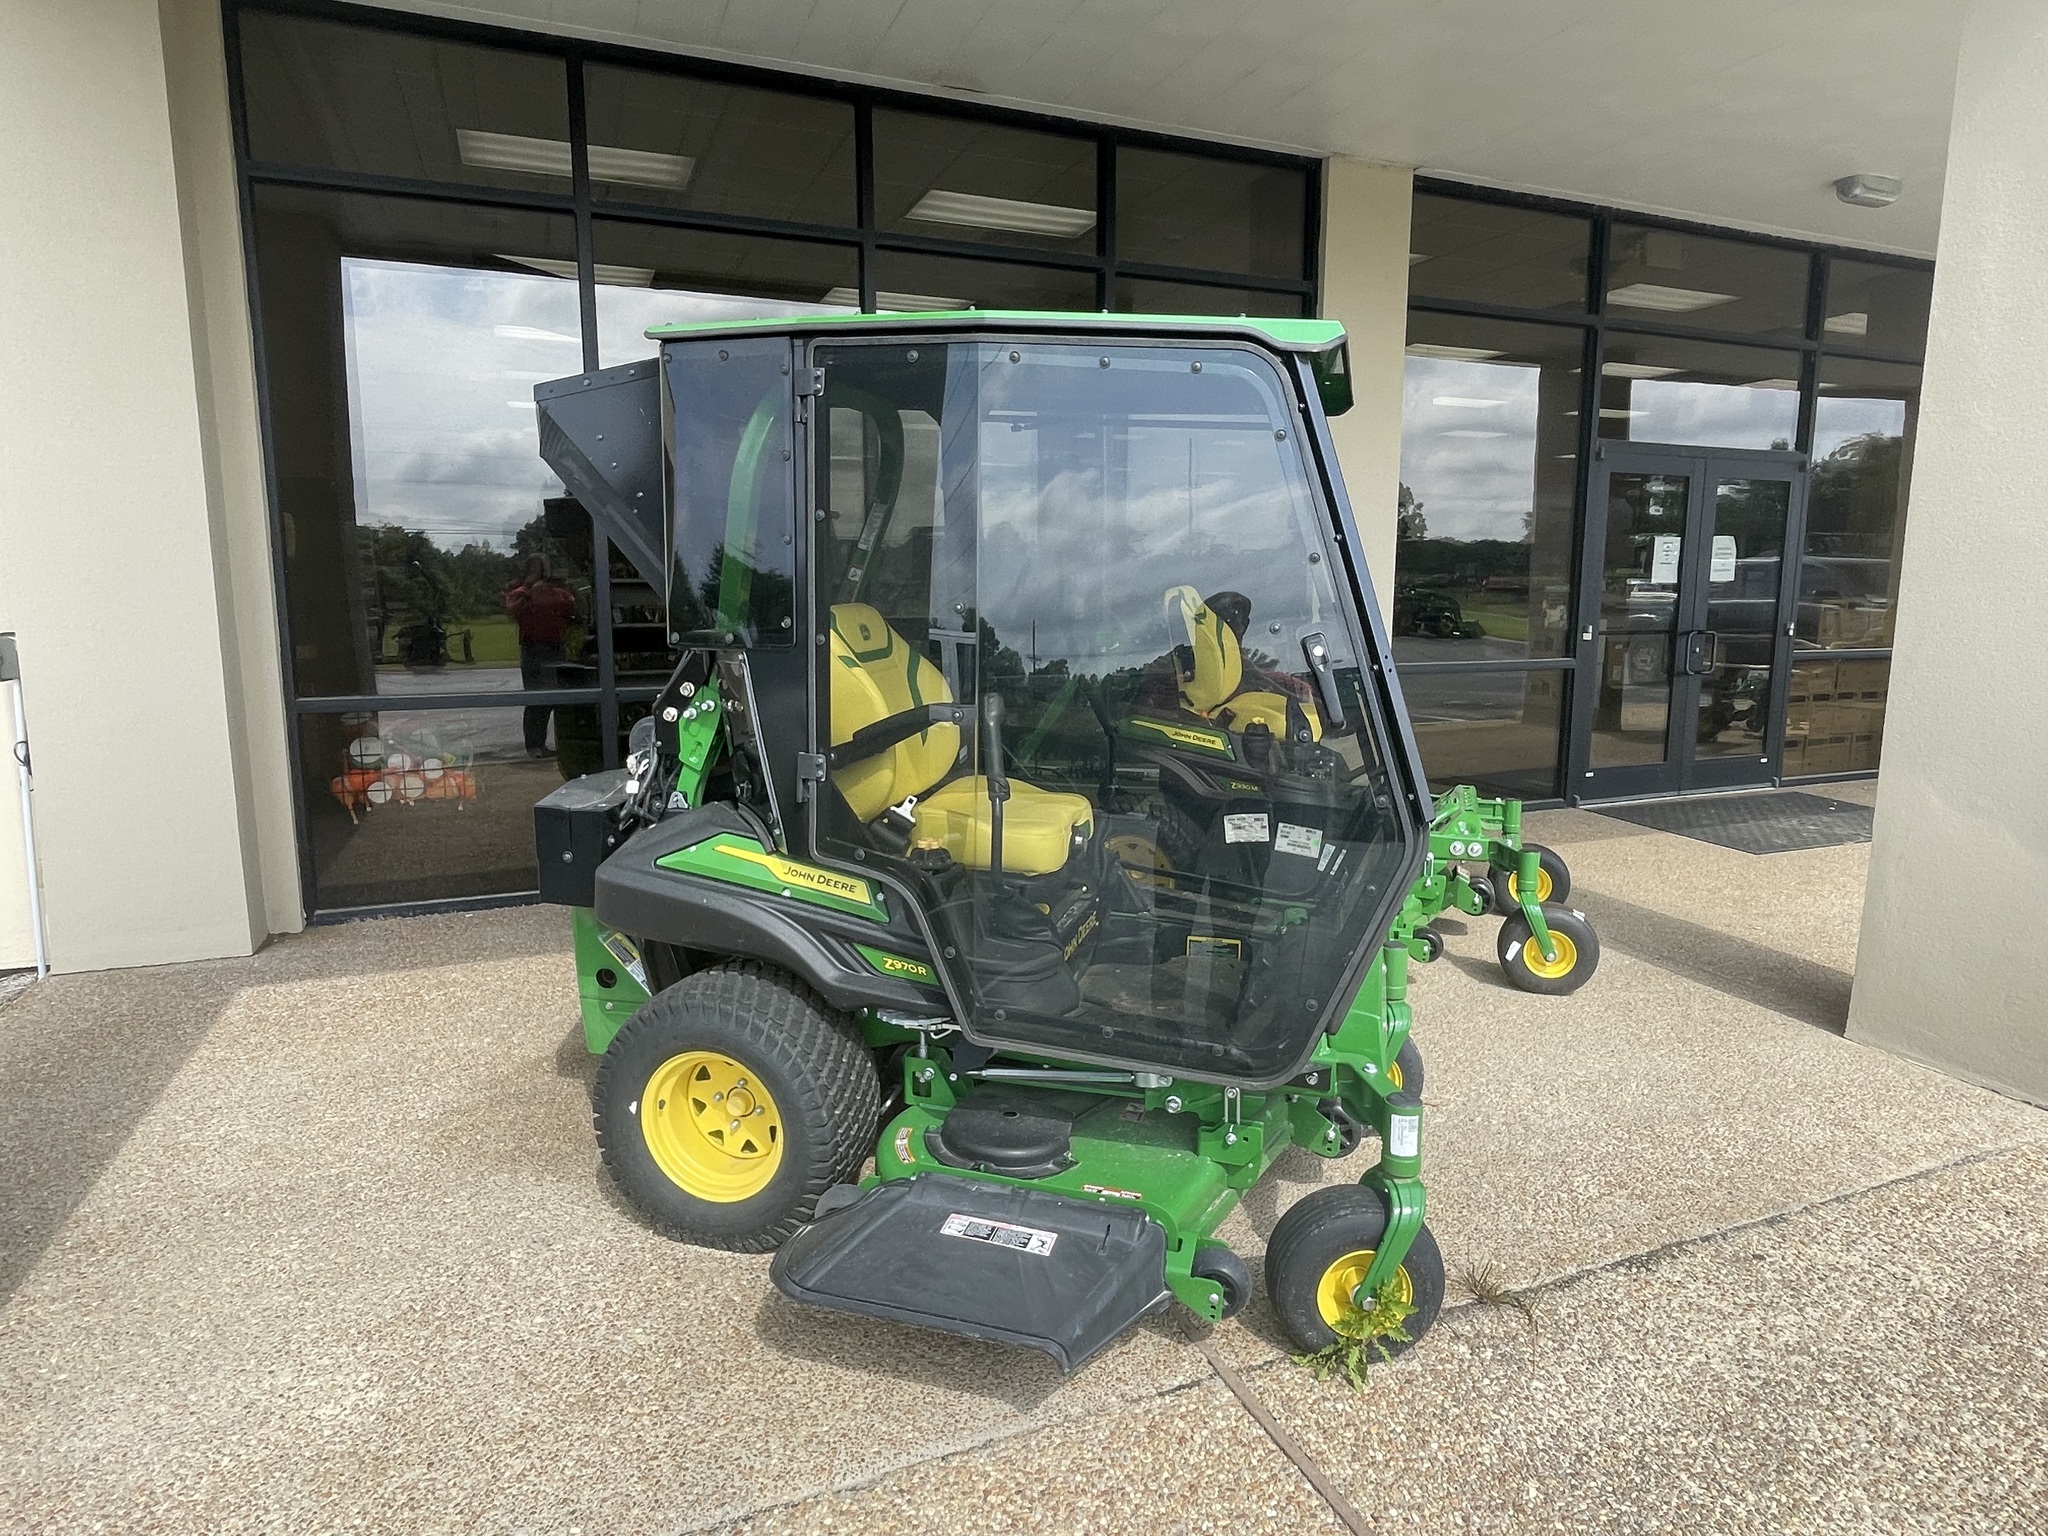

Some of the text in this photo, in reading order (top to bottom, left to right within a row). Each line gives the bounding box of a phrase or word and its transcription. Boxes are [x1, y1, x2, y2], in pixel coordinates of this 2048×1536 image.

[1172, 730, 1216, 745] JOHN DEERE
[783, 866, 857, 893] JOHN DEERE
[882, 957, 927, 976] Z970R
